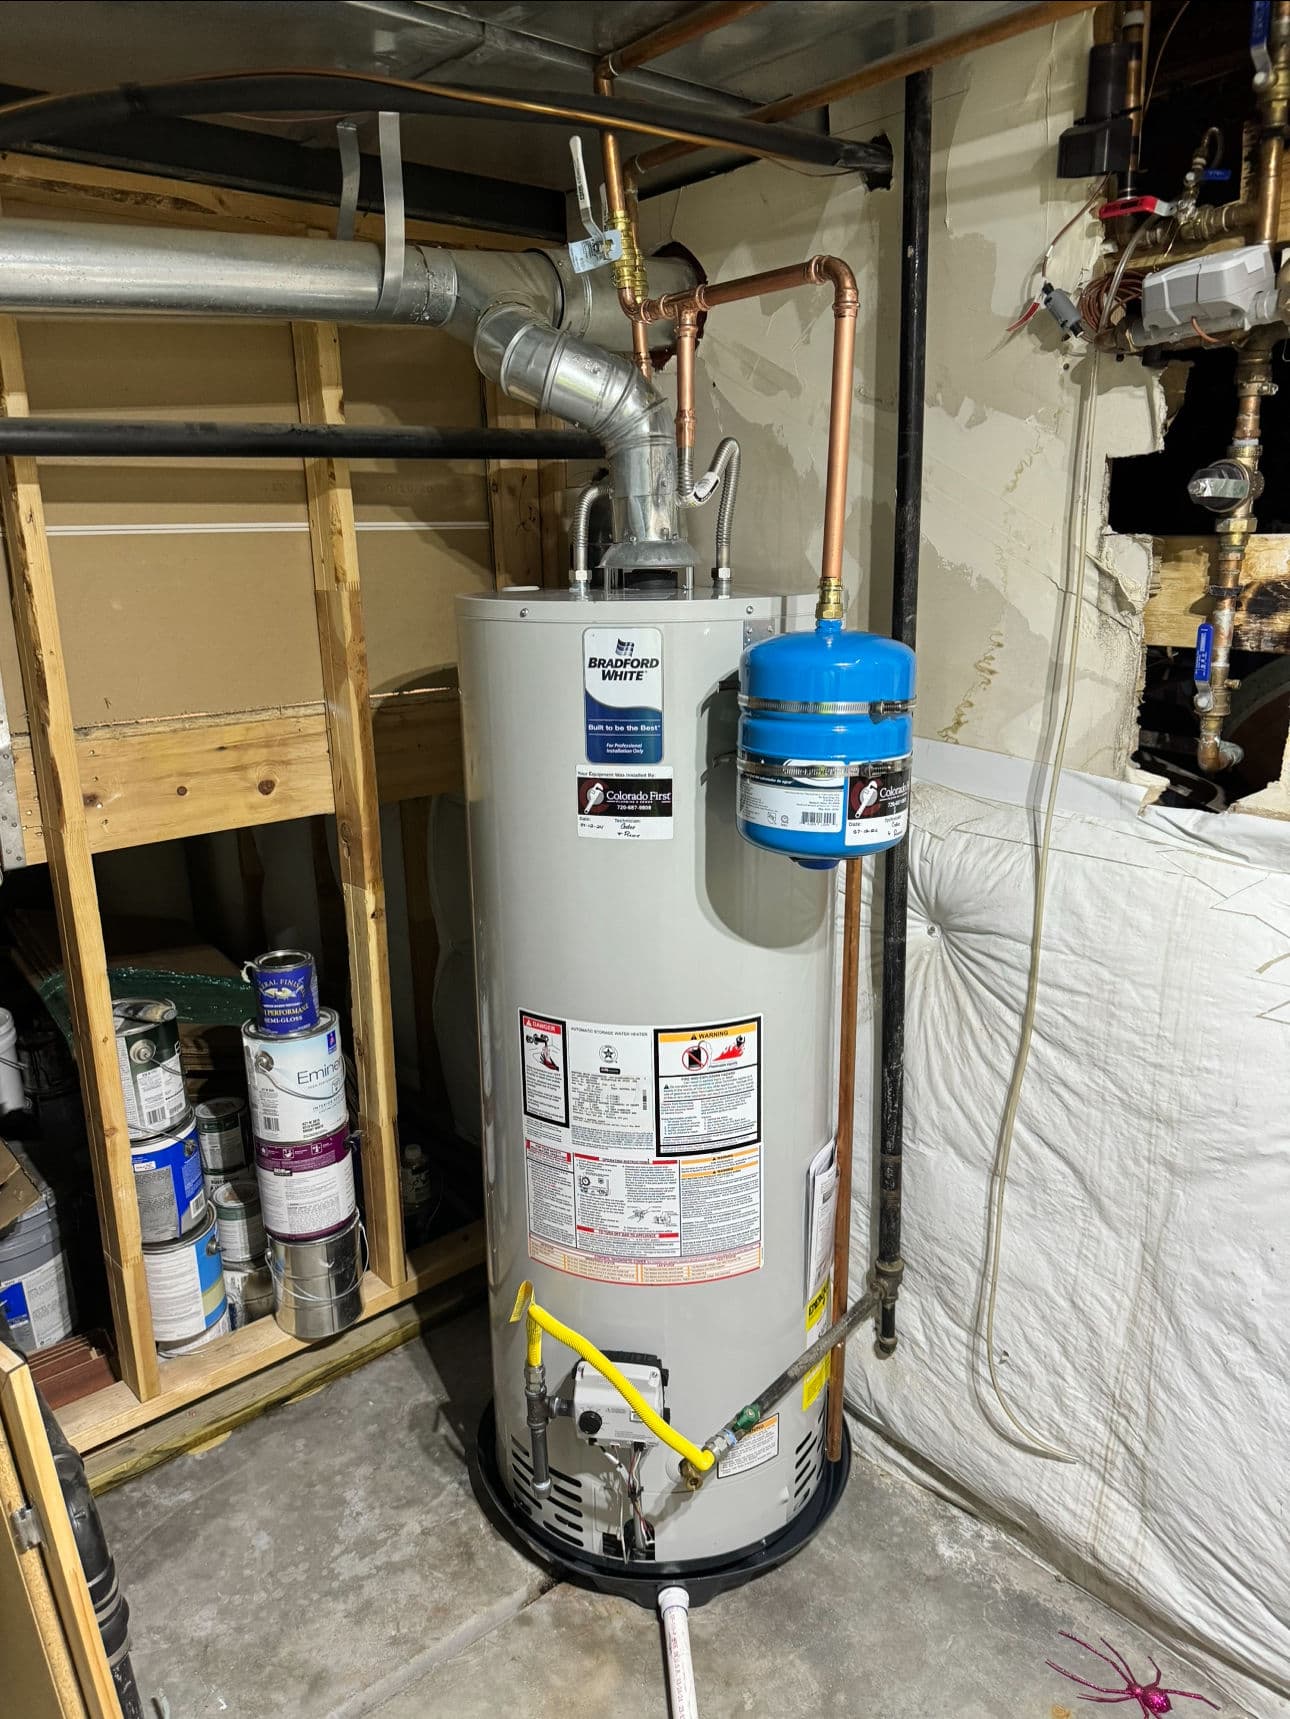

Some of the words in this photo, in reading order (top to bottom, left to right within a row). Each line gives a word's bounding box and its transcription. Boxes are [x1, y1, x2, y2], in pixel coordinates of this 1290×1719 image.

[588, 657, 660, 669] BRADFORD
[601, 670, 644, 681] WHITE
[606, 791, 648, 801] Colorado
[649, 792, 672, 801] First
[532, 1020, 556, 1032] DANGER
[698, 1030, 729, 1039] WARNING
